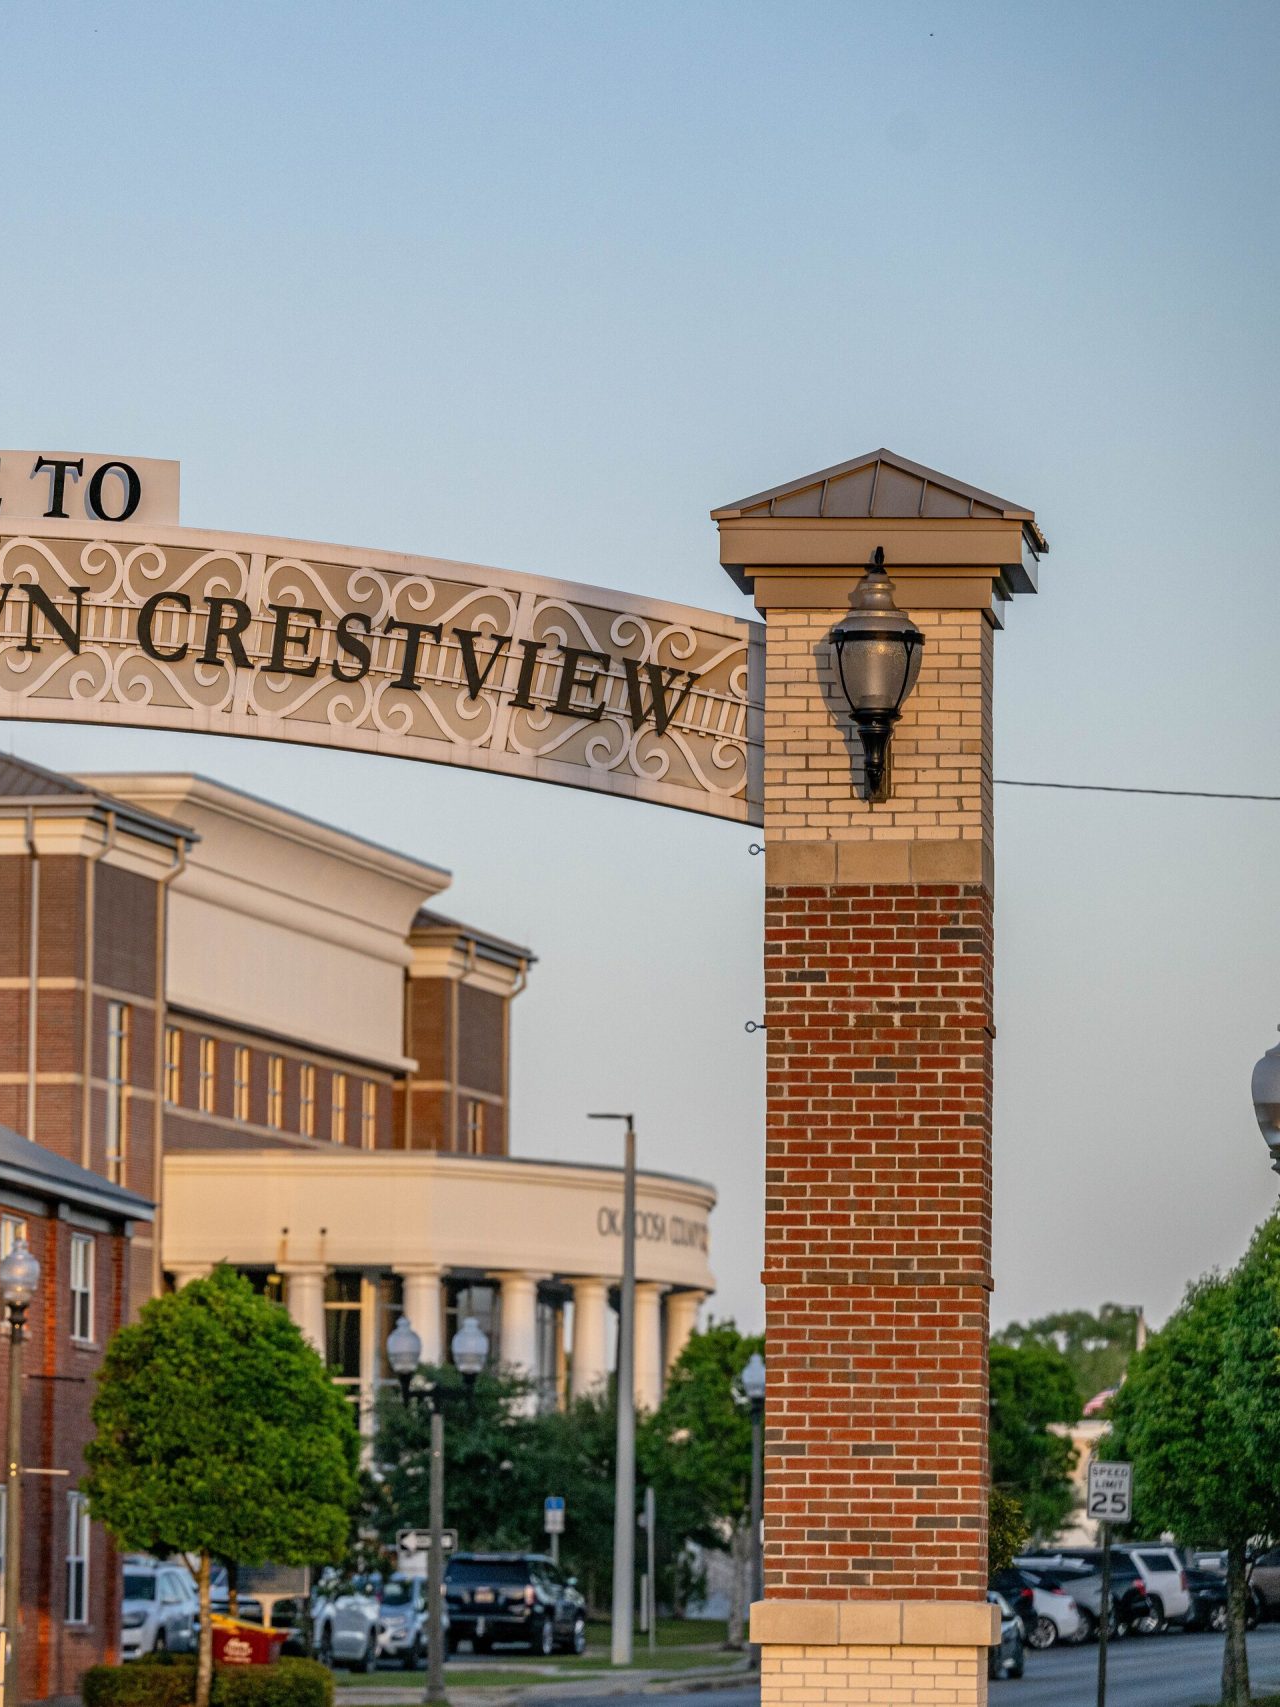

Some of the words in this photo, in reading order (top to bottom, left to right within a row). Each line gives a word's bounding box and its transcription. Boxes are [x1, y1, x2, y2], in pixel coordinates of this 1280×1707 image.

[33, 455, 142, 523] TO
[136, 591, 701, 737] CRESTVIEW
[598, 1207, 665, 1241] OKOOSA
[1092, 1467, 1128, 1477] SPEED
[1095, 1480, 1123, 1489] LIMIT
[1091, 1492, 1127, 1513] 25
